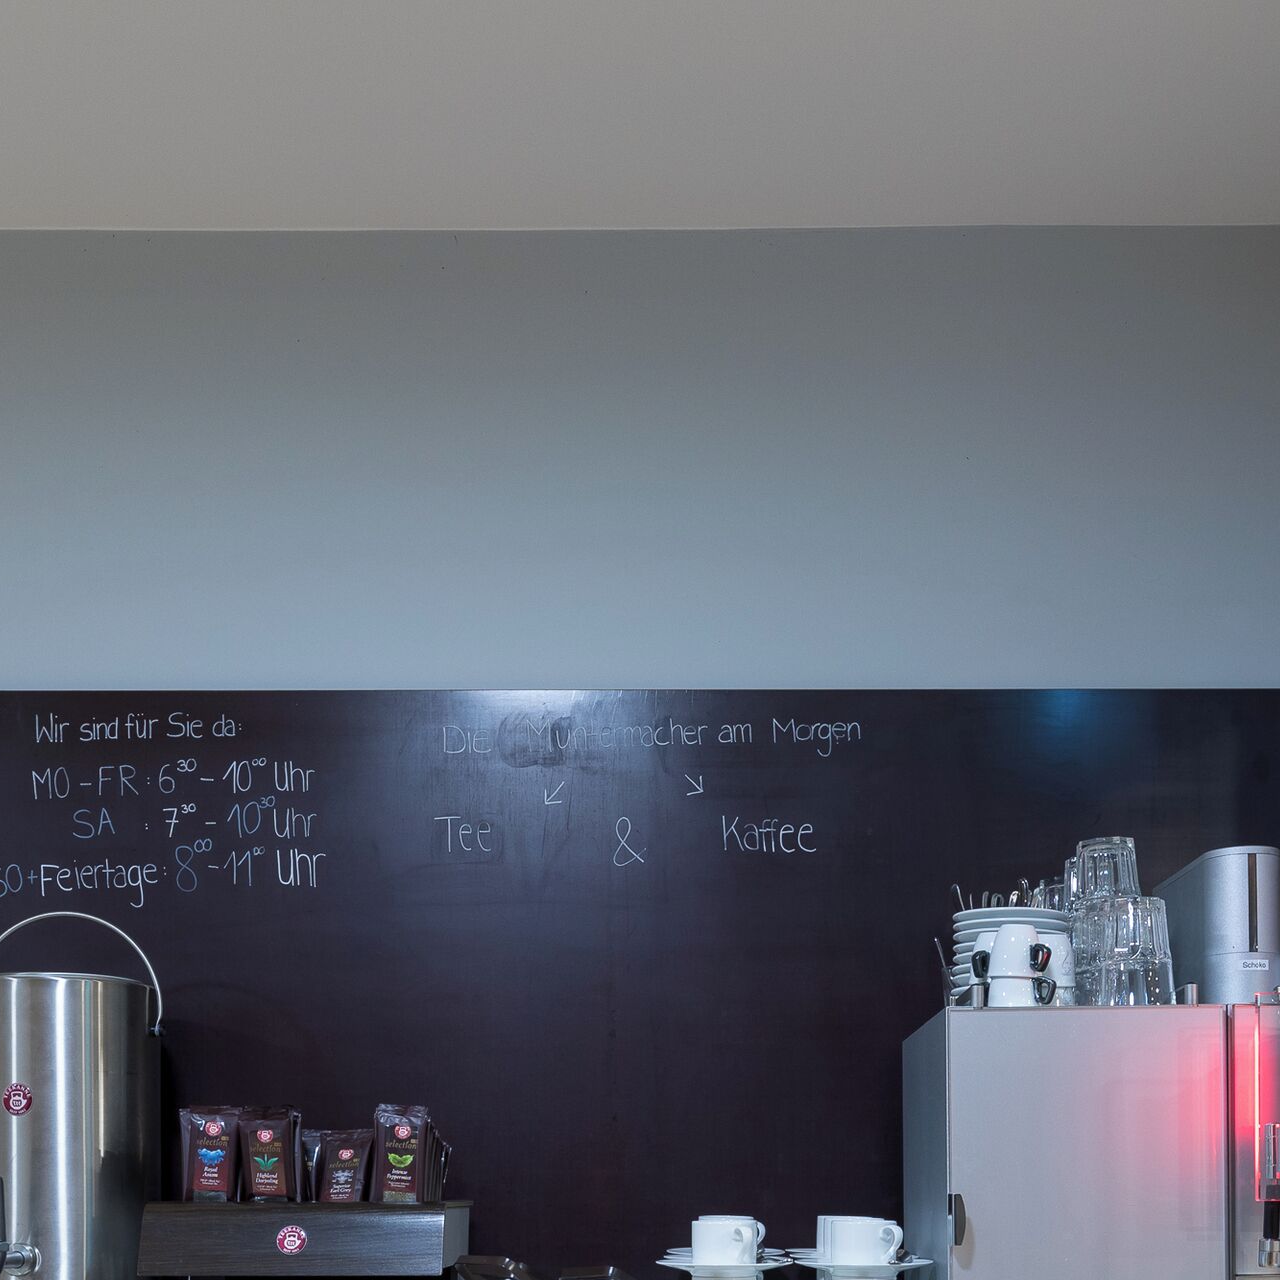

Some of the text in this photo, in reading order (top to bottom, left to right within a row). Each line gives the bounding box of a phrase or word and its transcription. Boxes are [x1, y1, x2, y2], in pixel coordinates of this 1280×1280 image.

[35, 712, 243, 743] Wir sind für Sie da:
[718, 724, 752, 743] am
[772, 717, 861, 758] Morgen
[274, 760, 316, 793] Uhr
[72, 807, 116, 839] SA
[273, 807, 318, 839] Uhr
[433, 815, 817, 867] Tee & Kaffee
[276, 848, 326, 888] Uhr
[1242, 961, 1267, 969] Schoko
